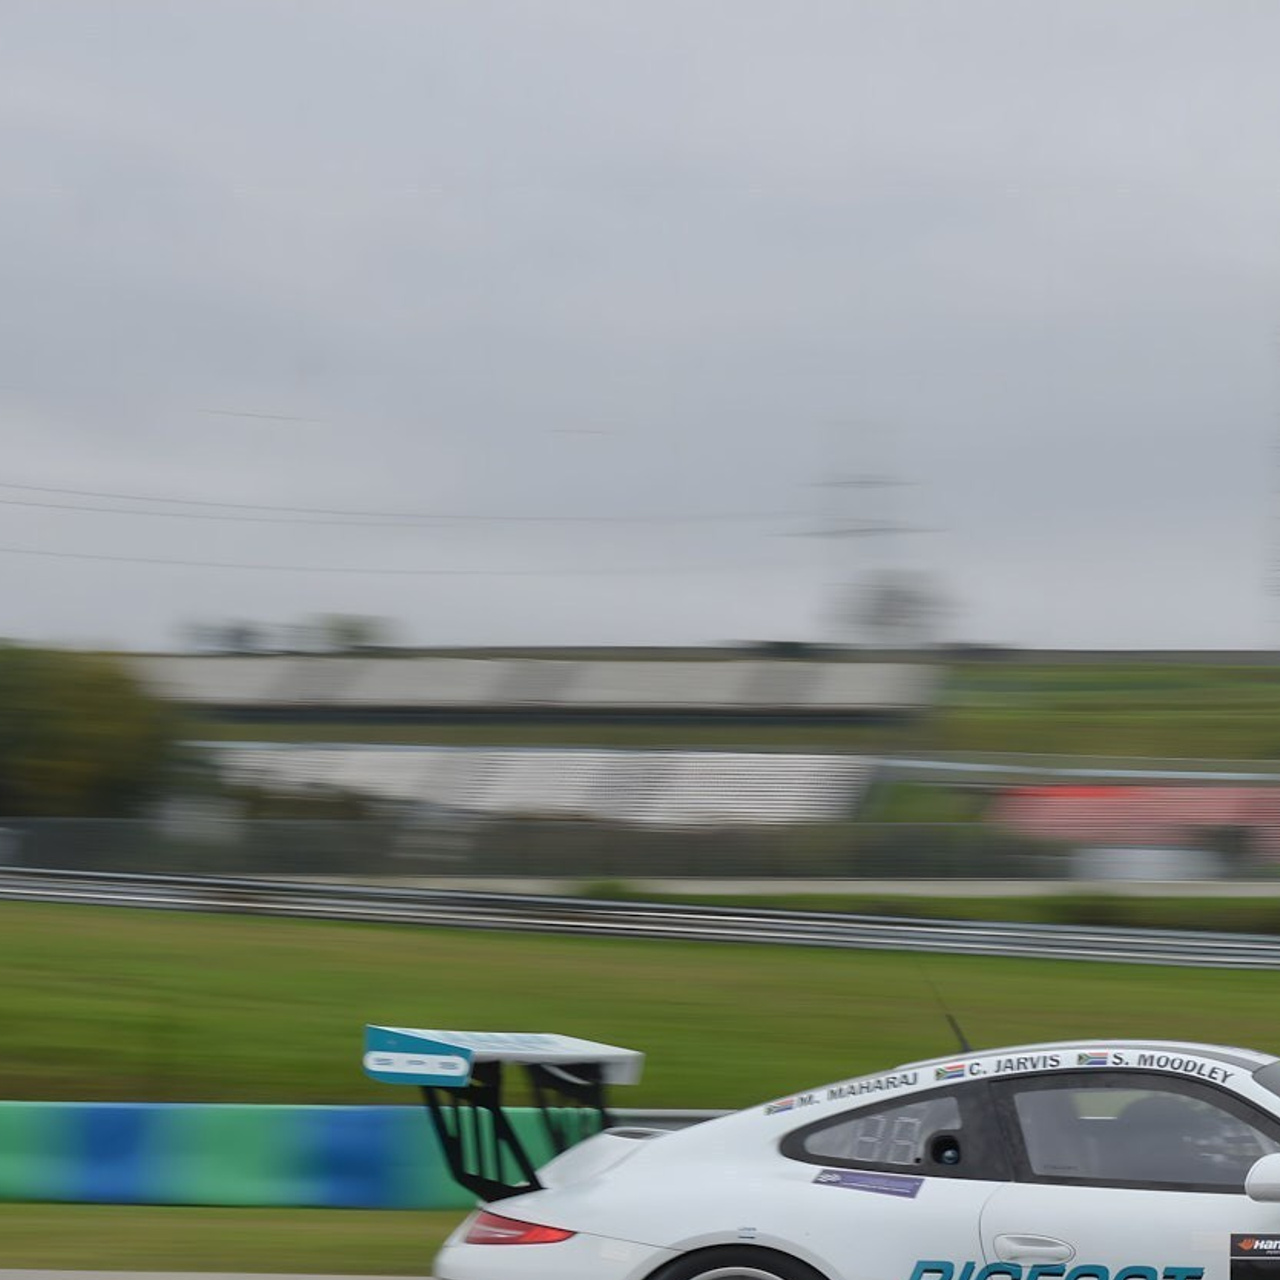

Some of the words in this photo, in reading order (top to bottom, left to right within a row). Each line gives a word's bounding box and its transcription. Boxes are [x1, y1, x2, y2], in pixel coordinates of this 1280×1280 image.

[968, 1062, 987, 1076] C.
[994, 1053, 1061, 1074] JARVIS
[1111, 1053, 1129, 1066] S.
[1137, 1053, 1234, 1084] MOODLEY
[827, 1073, 917, 1099] MAHARAJ
